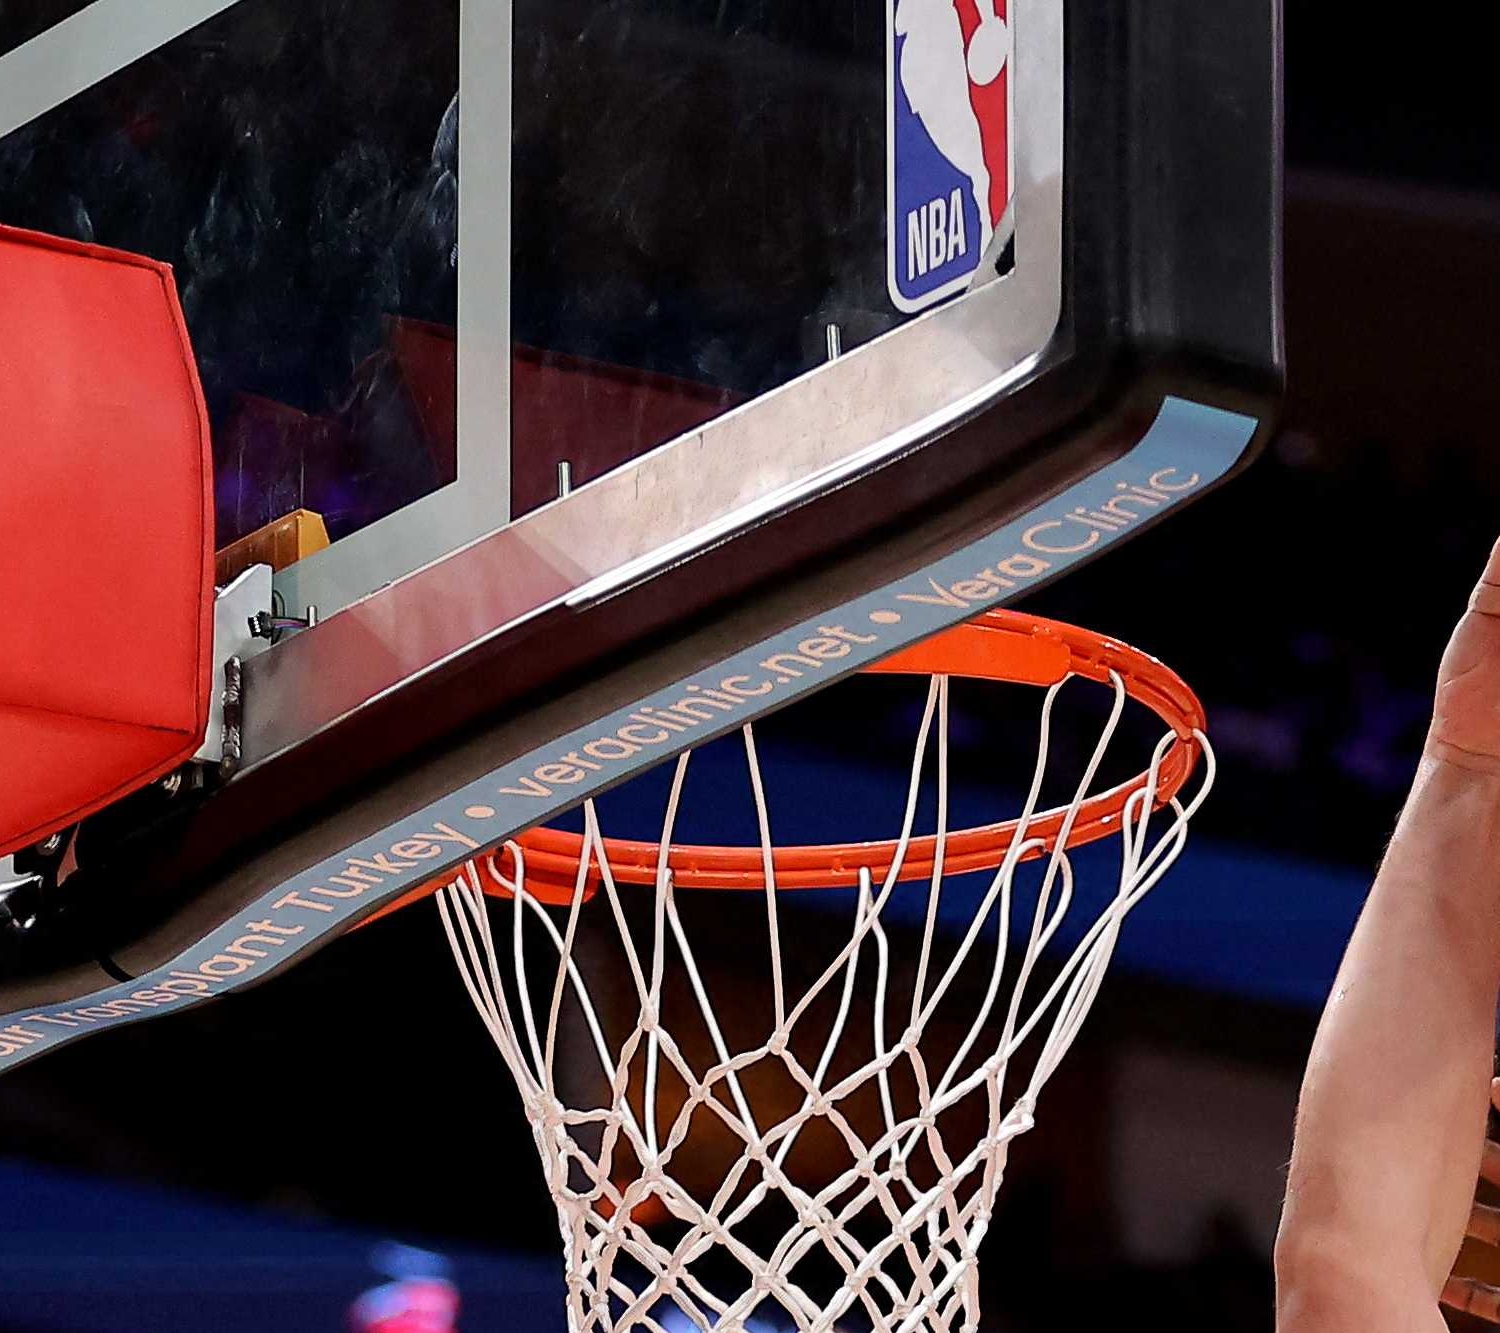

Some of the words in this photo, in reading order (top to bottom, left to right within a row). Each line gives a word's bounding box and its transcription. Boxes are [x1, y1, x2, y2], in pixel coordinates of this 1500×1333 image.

[906, 187, 967, 282] NBA
[25, 917, 306, 1030] Transplant
[274, 821, 480, 914] Turkey
[500, 623, 880, 799] veraclinic.net
